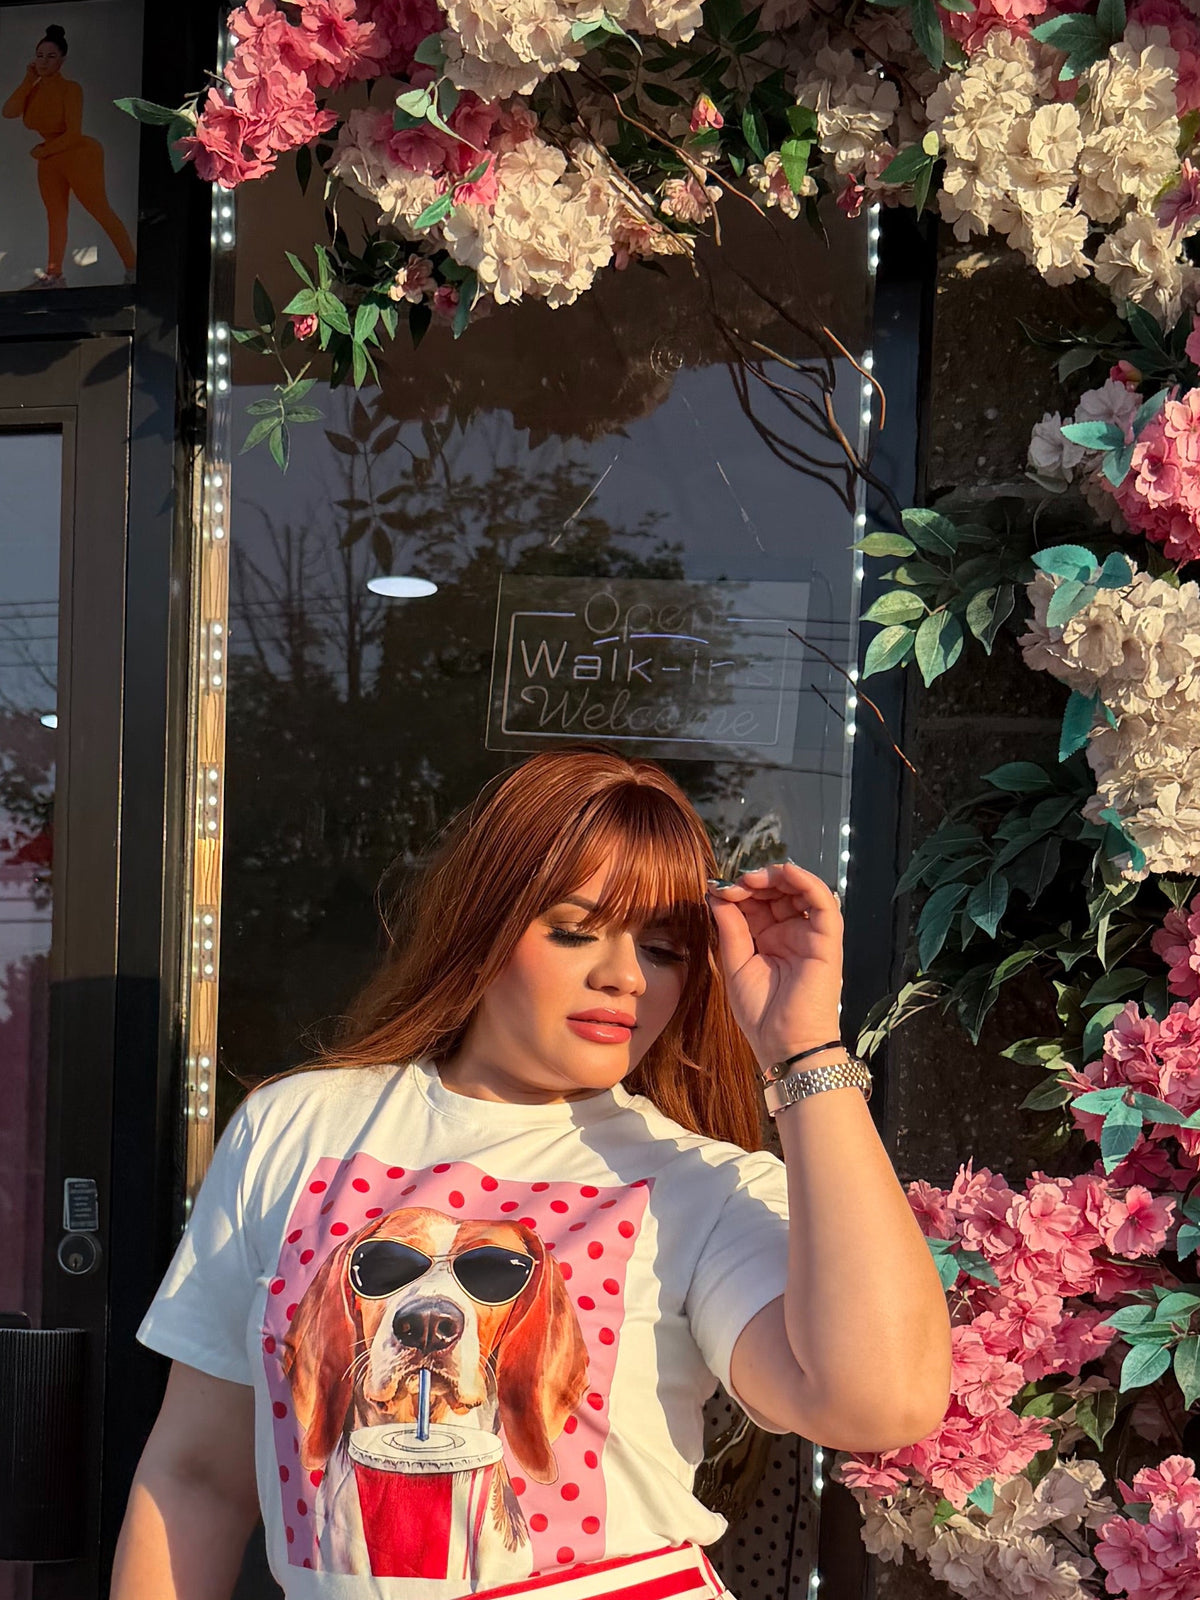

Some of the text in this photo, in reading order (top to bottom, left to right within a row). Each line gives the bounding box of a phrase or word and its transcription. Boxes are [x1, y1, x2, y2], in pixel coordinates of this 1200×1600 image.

[584, 591, 716, 644] Open
[520, 639, 774, 687] Walk-ins
[520, 685, 760, 738] Welcome
